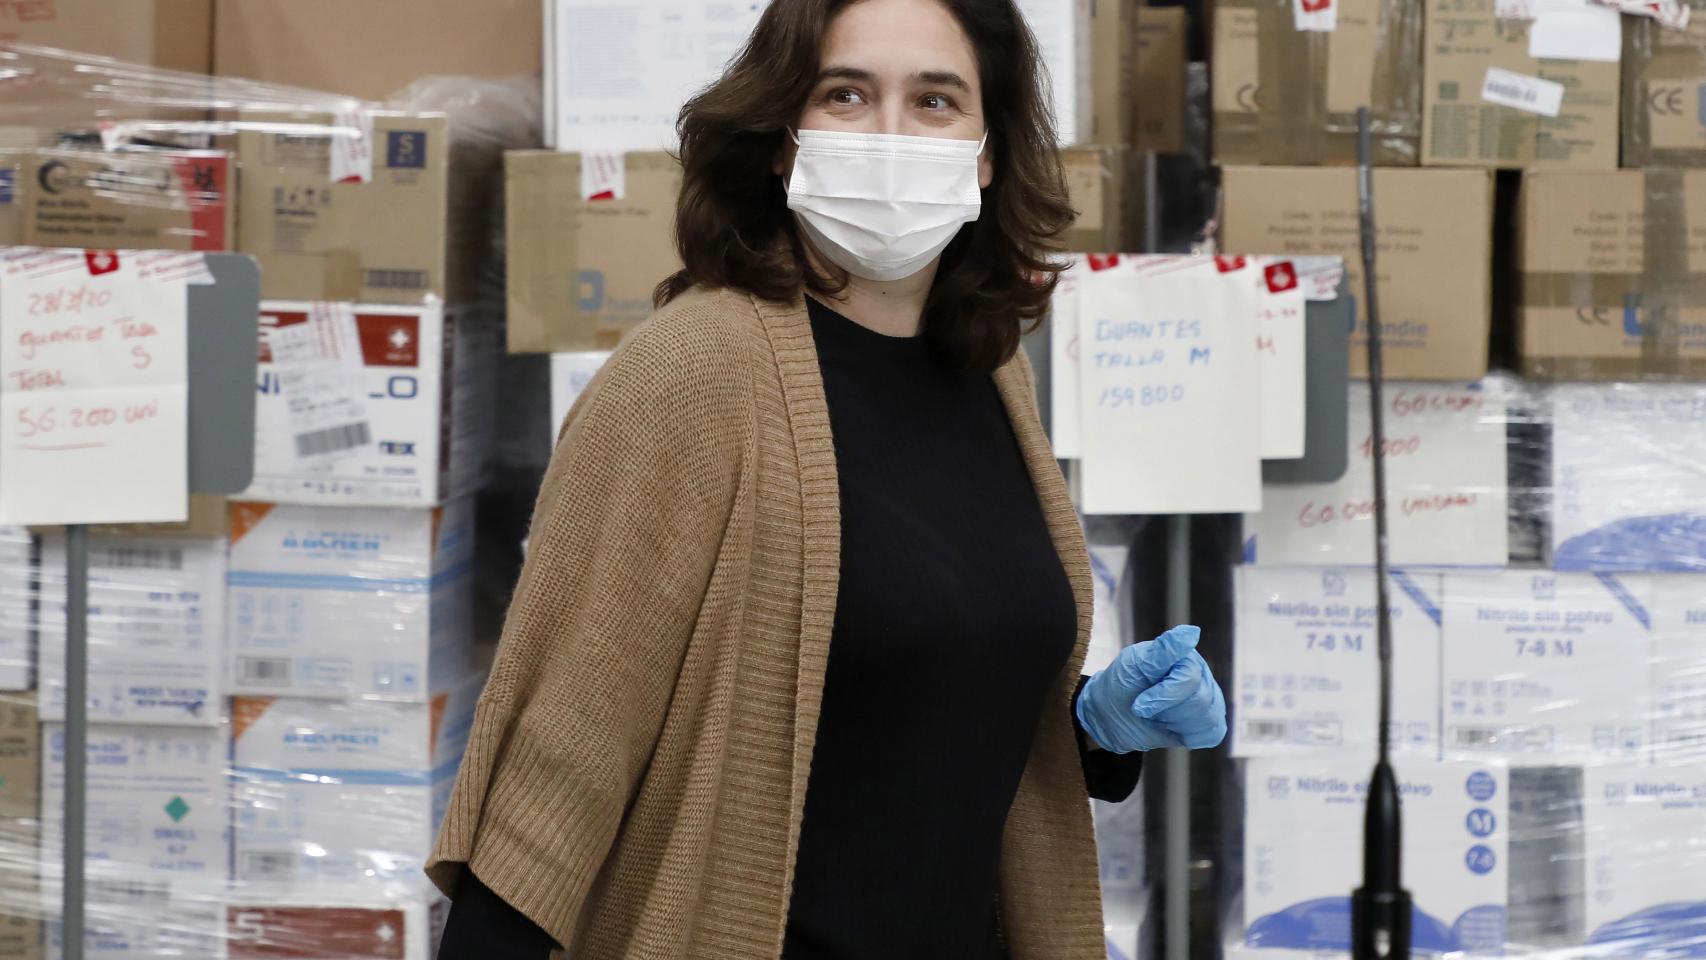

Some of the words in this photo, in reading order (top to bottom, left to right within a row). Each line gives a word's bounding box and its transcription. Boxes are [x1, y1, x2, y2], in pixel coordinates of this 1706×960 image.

[1188, 347, 1212, 366] M
[1342, 633, 1363, 652] M
[1552, 638, 1574, 657] M
[1471, 812, 1491, 833] M
